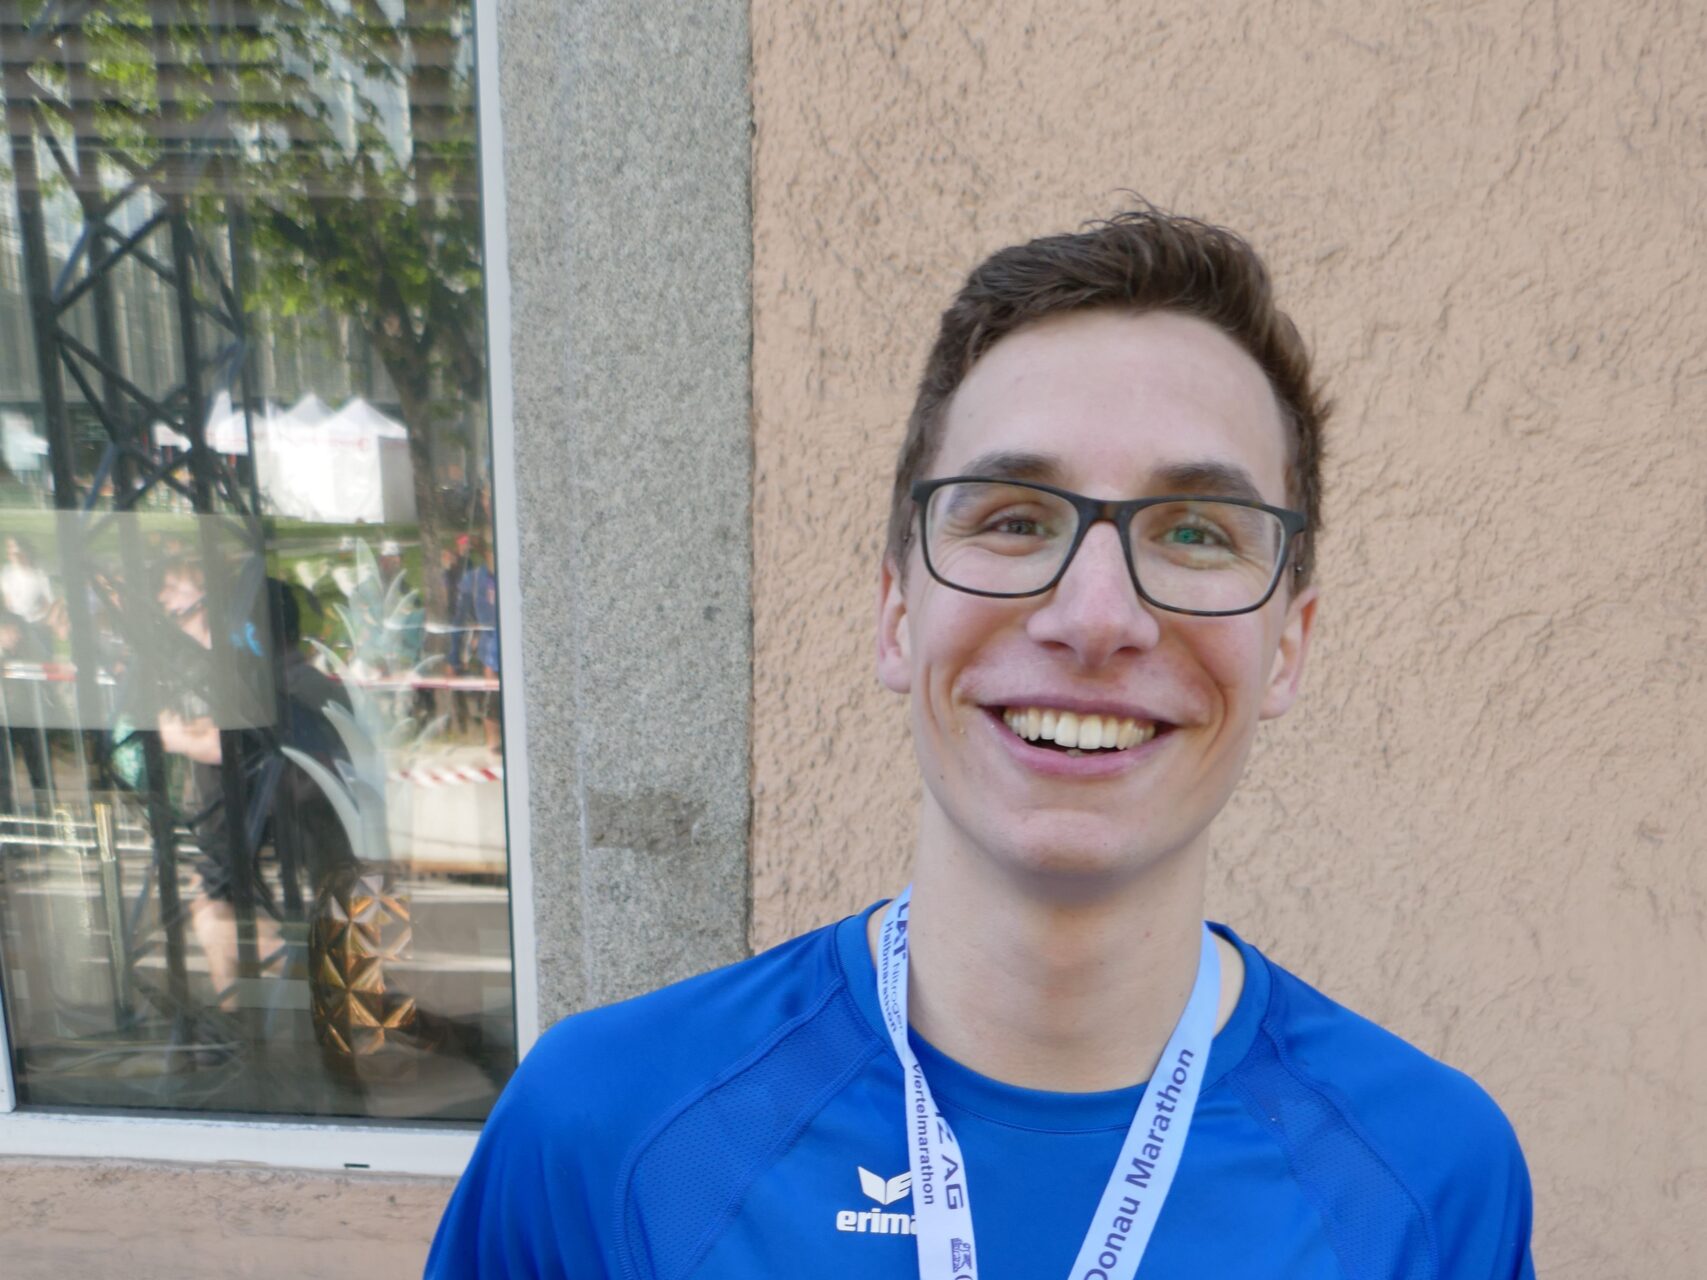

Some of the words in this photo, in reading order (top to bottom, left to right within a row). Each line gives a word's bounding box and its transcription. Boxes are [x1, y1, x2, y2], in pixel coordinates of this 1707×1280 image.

[882, 920, 897, 1033] Halbmarathon
[912, 1063, 935, 1205] Viertelmarathon
[1126, 1048, 1194, 1188] Marathon
[941, 1154, 964, 1210] AG
